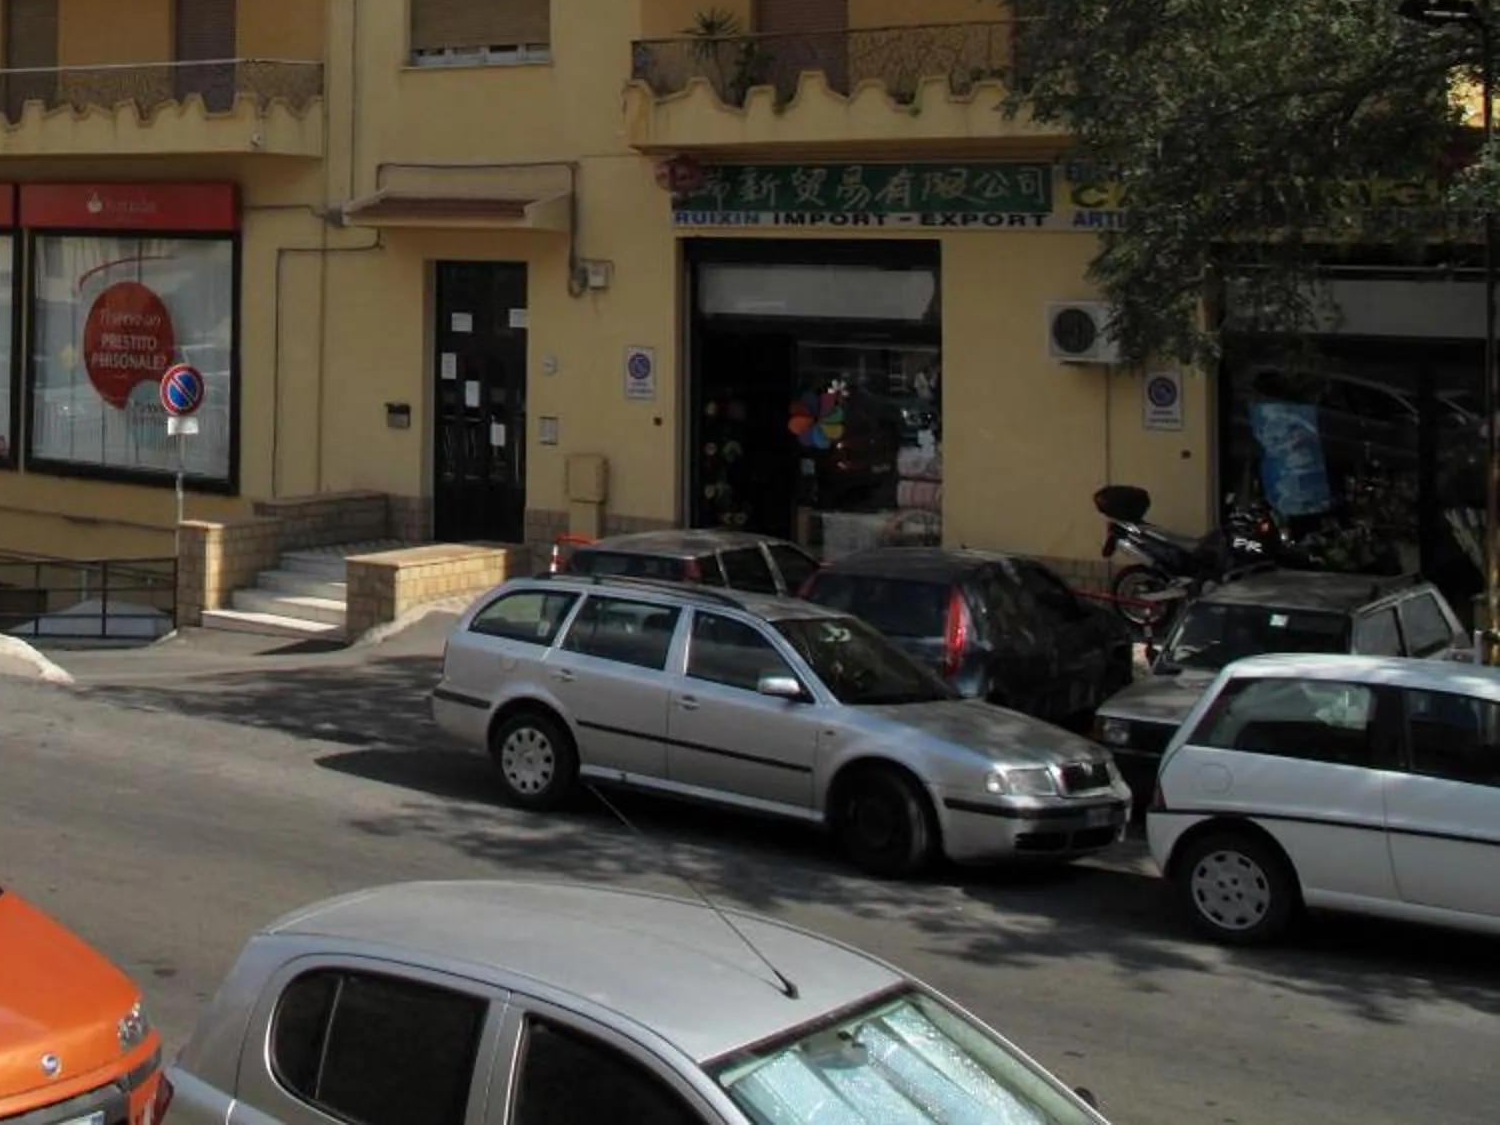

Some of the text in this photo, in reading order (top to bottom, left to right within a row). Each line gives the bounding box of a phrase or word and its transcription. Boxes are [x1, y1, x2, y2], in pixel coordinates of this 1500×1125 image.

[674, 211, 760, 225] RUIXIN
[773, 211, 888, 227] IMPORT
[921, 211, 1048, 227] EXPORT
[101, 333, 158, 351] PRESTITO
